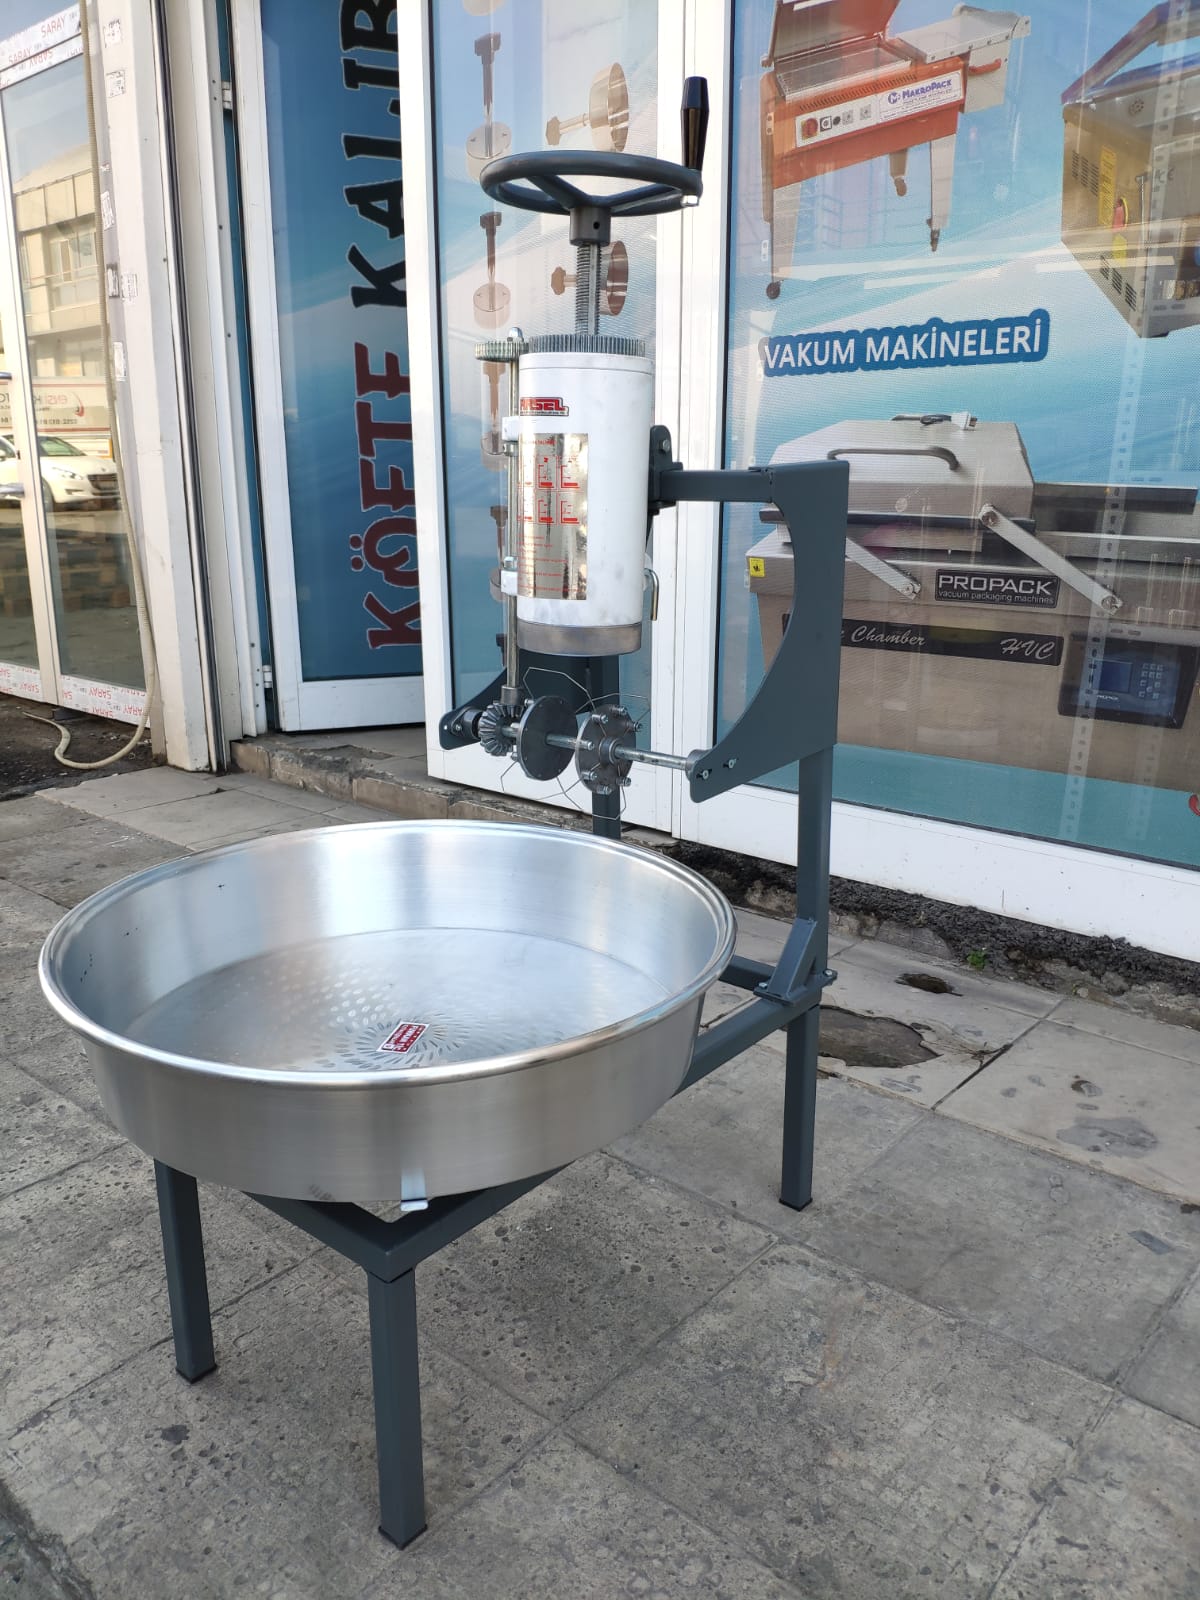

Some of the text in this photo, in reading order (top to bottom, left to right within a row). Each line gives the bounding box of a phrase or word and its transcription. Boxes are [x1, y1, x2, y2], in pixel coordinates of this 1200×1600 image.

[41, 15, 65, 38] SARAY
[764, 318, 1042, 369] VAKUM MAKİNELERİ
[939, 575, 1053, 595] PROPACK
[940, 590, 1054, 604] vacuum packaging machines
[851, 625, 926, 646] Chamber
[1000, 638, 1055, 660] HVC
[88, 687, 112, 700] SARAY
[123, 705, 143, 716] ARAY
